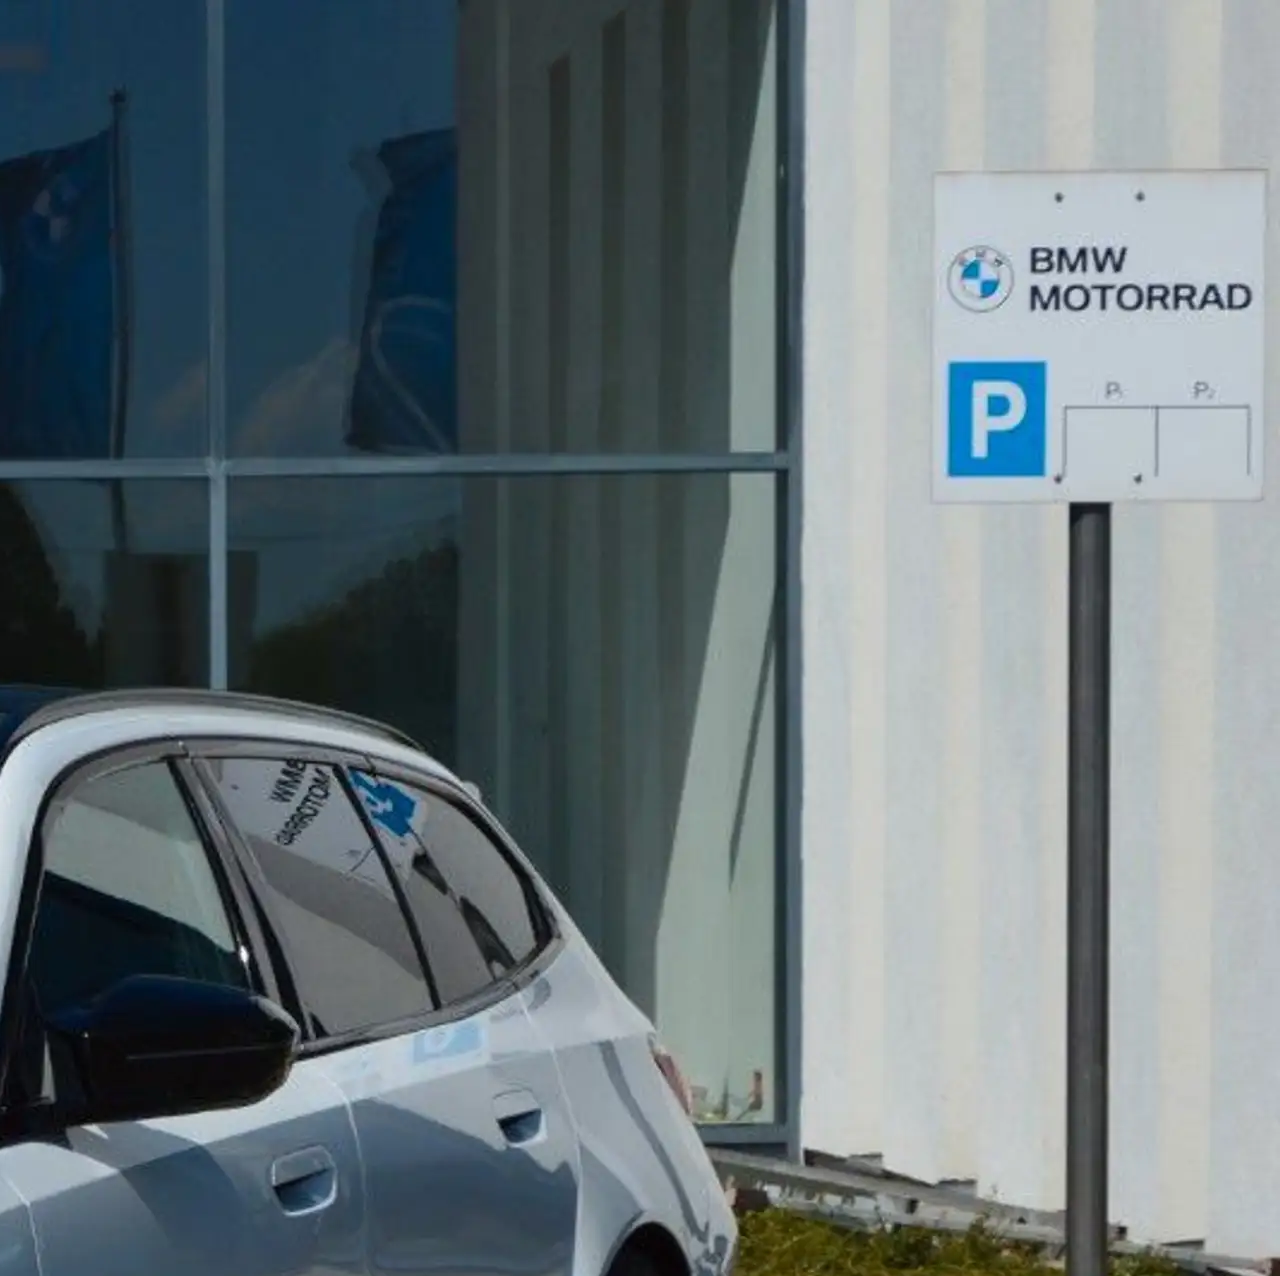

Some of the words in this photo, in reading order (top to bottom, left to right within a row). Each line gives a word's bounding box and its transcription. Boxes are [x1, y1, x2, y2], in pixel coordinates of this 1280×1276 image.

[1029, 246, 1128, 274] BMW
[1029, 284, 1253, 312] MOTORRAD
[971, 380, 1027, 459] P
